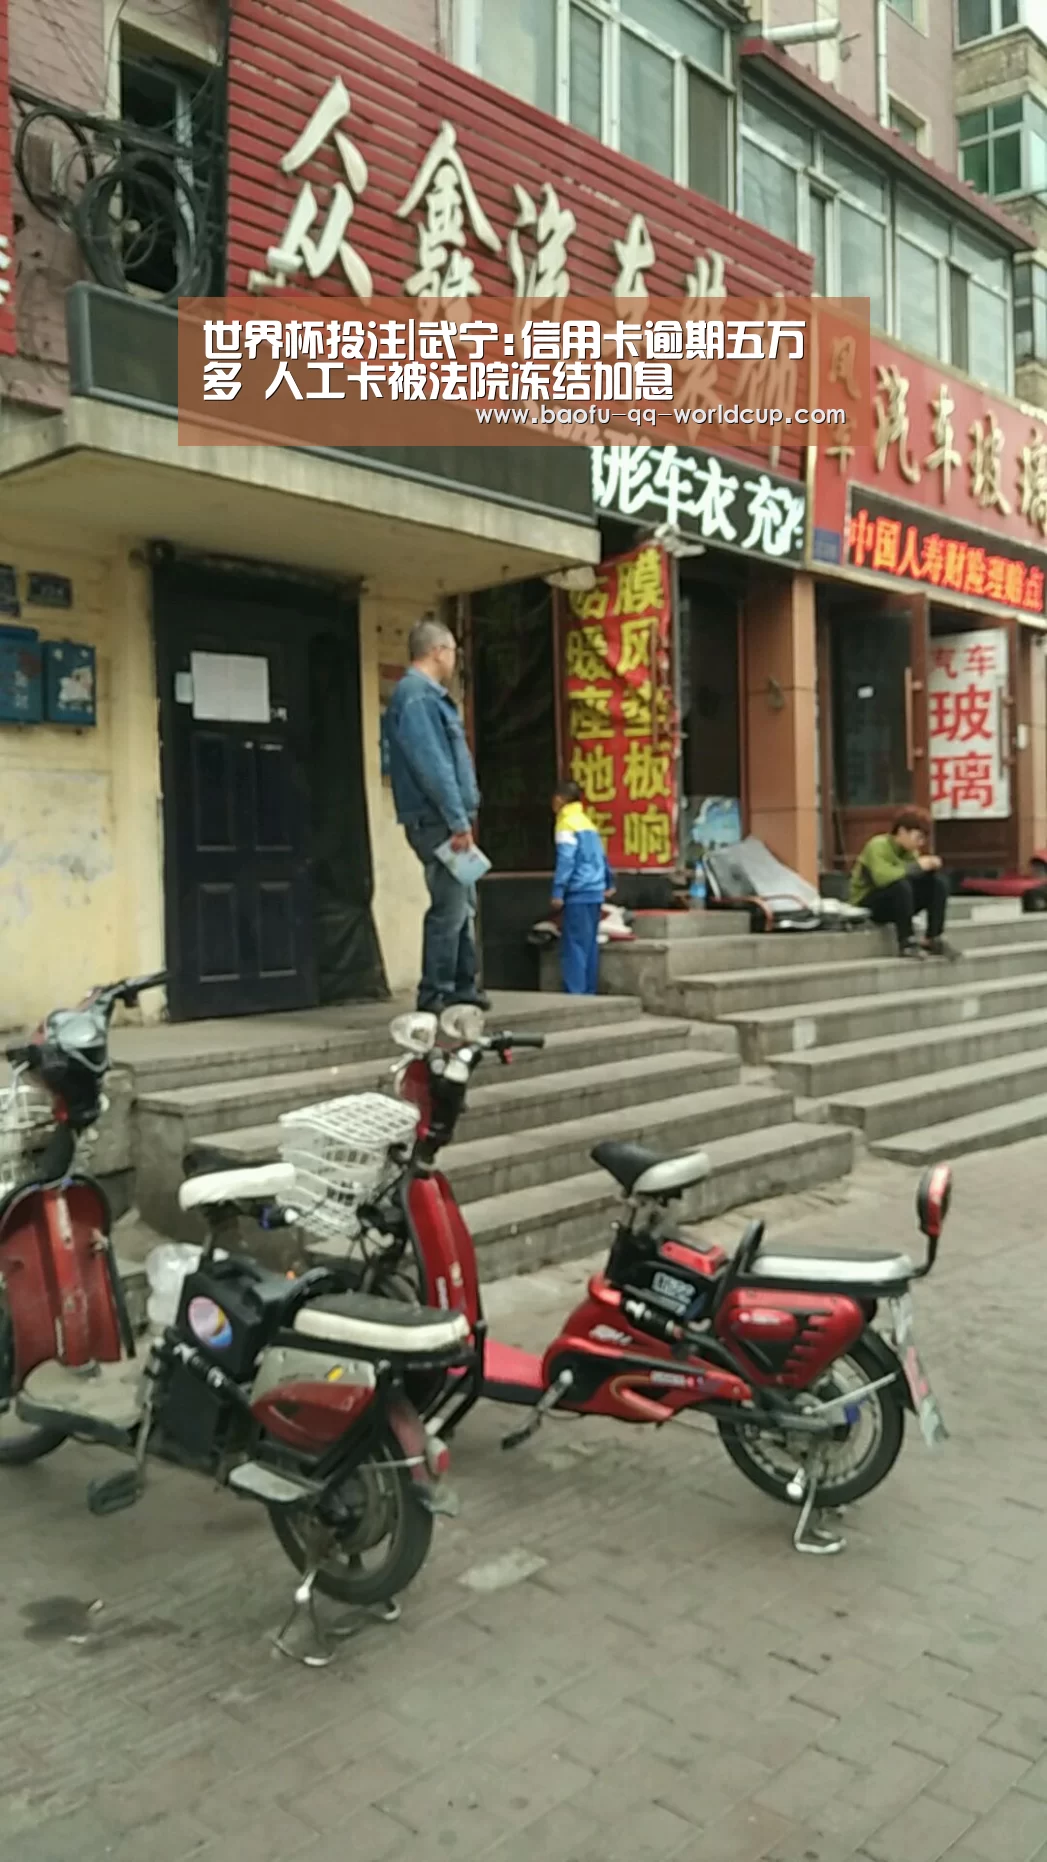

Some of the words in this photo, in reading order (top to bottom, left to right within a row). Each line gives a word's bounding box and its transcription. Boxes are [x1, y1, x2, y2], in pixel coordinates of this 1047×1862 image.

[872, 362, 1047, 537] 汽车玻璃
[848, 508, 1045, 613] 中国人寿财险理赔点
[930, 684, 994, 811] 玻璃
